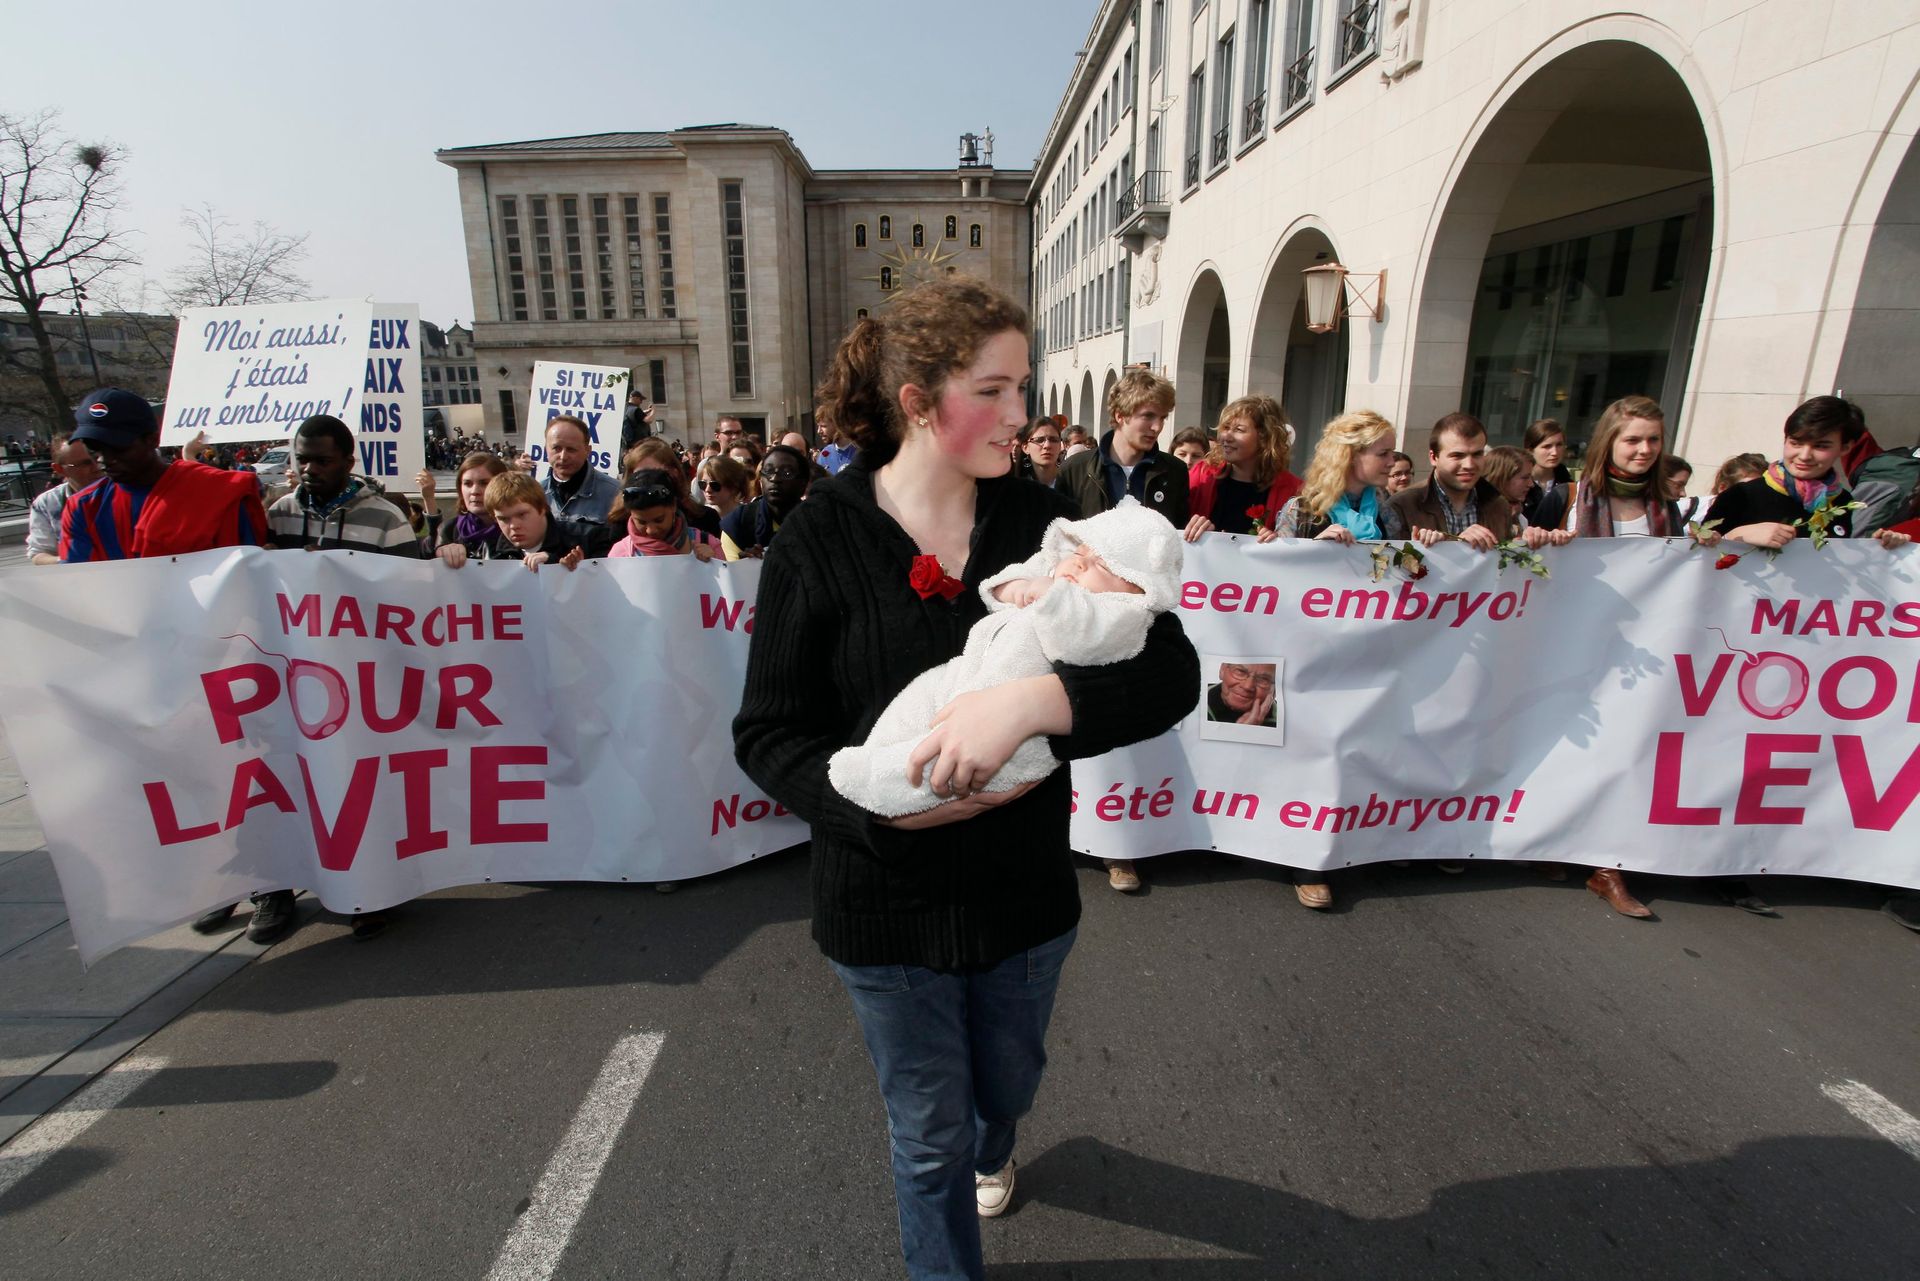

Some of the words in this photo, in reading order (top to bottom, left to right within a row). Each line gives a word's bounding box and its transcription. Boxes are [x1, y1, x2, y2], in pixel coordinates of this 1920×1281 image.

[204, 318, 264, 351] Moi
[264, 313, 347, 348] aussi,
[224, 353, 309, 399] j'étais
[539, 387, 586, 408] VEUX
[593, 392, 616, 411] LA
[556, 369, 574, 387] SI
[581, 371, 603, 389] TU
[173, 406, 211, 428] un
[359, 402, 402, 433] NDS
[359, 441, 399, 476] VIE
[276, 592, 524, 647] MARCHE
[1180, 580, 1279, 615] een
[1301, 579, 1532, 627] embryo!
[1750, 598, 1920, 638] MARS
[200, 658, 504, 744] POUR
[1674, 651, 1920, 723] VOO
[1648, 732, 1920, 831] LEV
[142, 756, 298, 846] LA
[296, 745, 549, 872] VIE
[1095, 777, 1174, 821] été
[1192, 789, 1260, 820] un
[1279, 789, 1526, 833] embryon!
